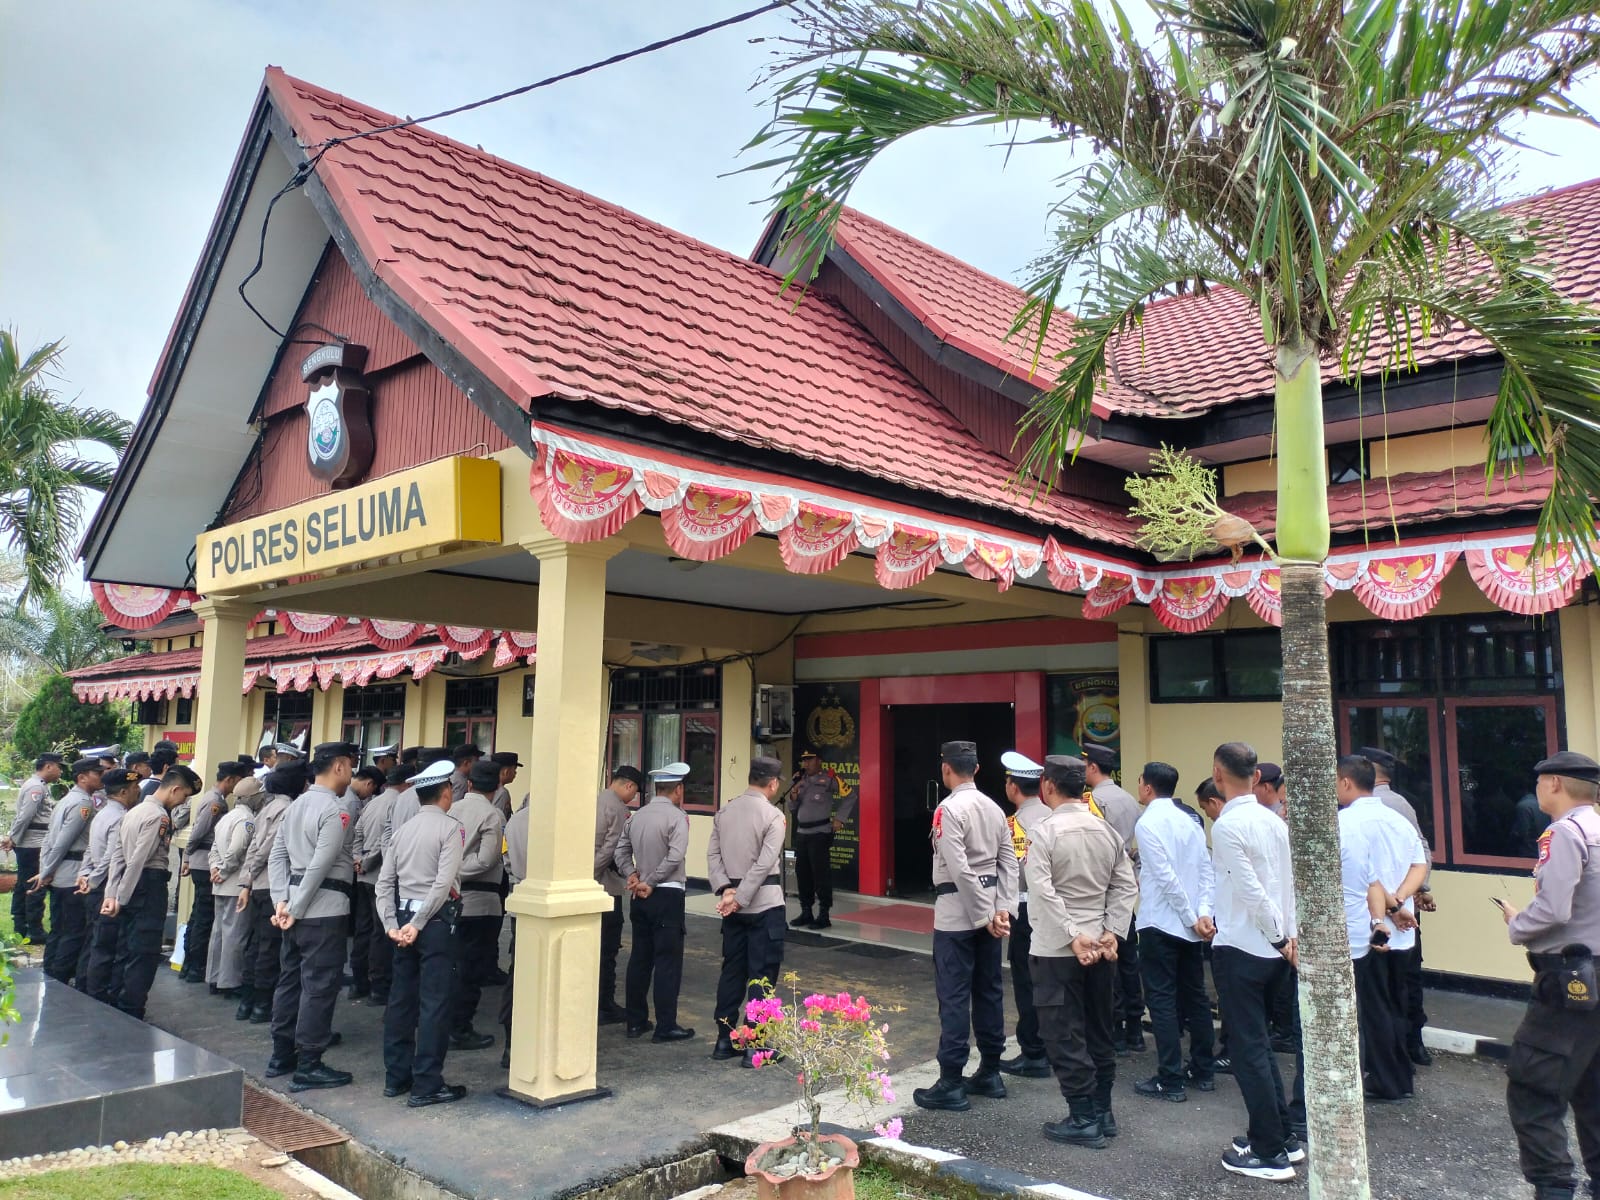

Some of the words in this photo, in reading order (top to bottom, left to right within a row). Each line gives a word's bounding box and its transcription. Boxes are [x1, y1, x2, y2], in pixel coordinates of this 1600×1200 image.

[302, 349, 341, 374] BENGKULU
[211, 518, 299, 579] POLRES
[306, 481, 428, 556] SELUMA
